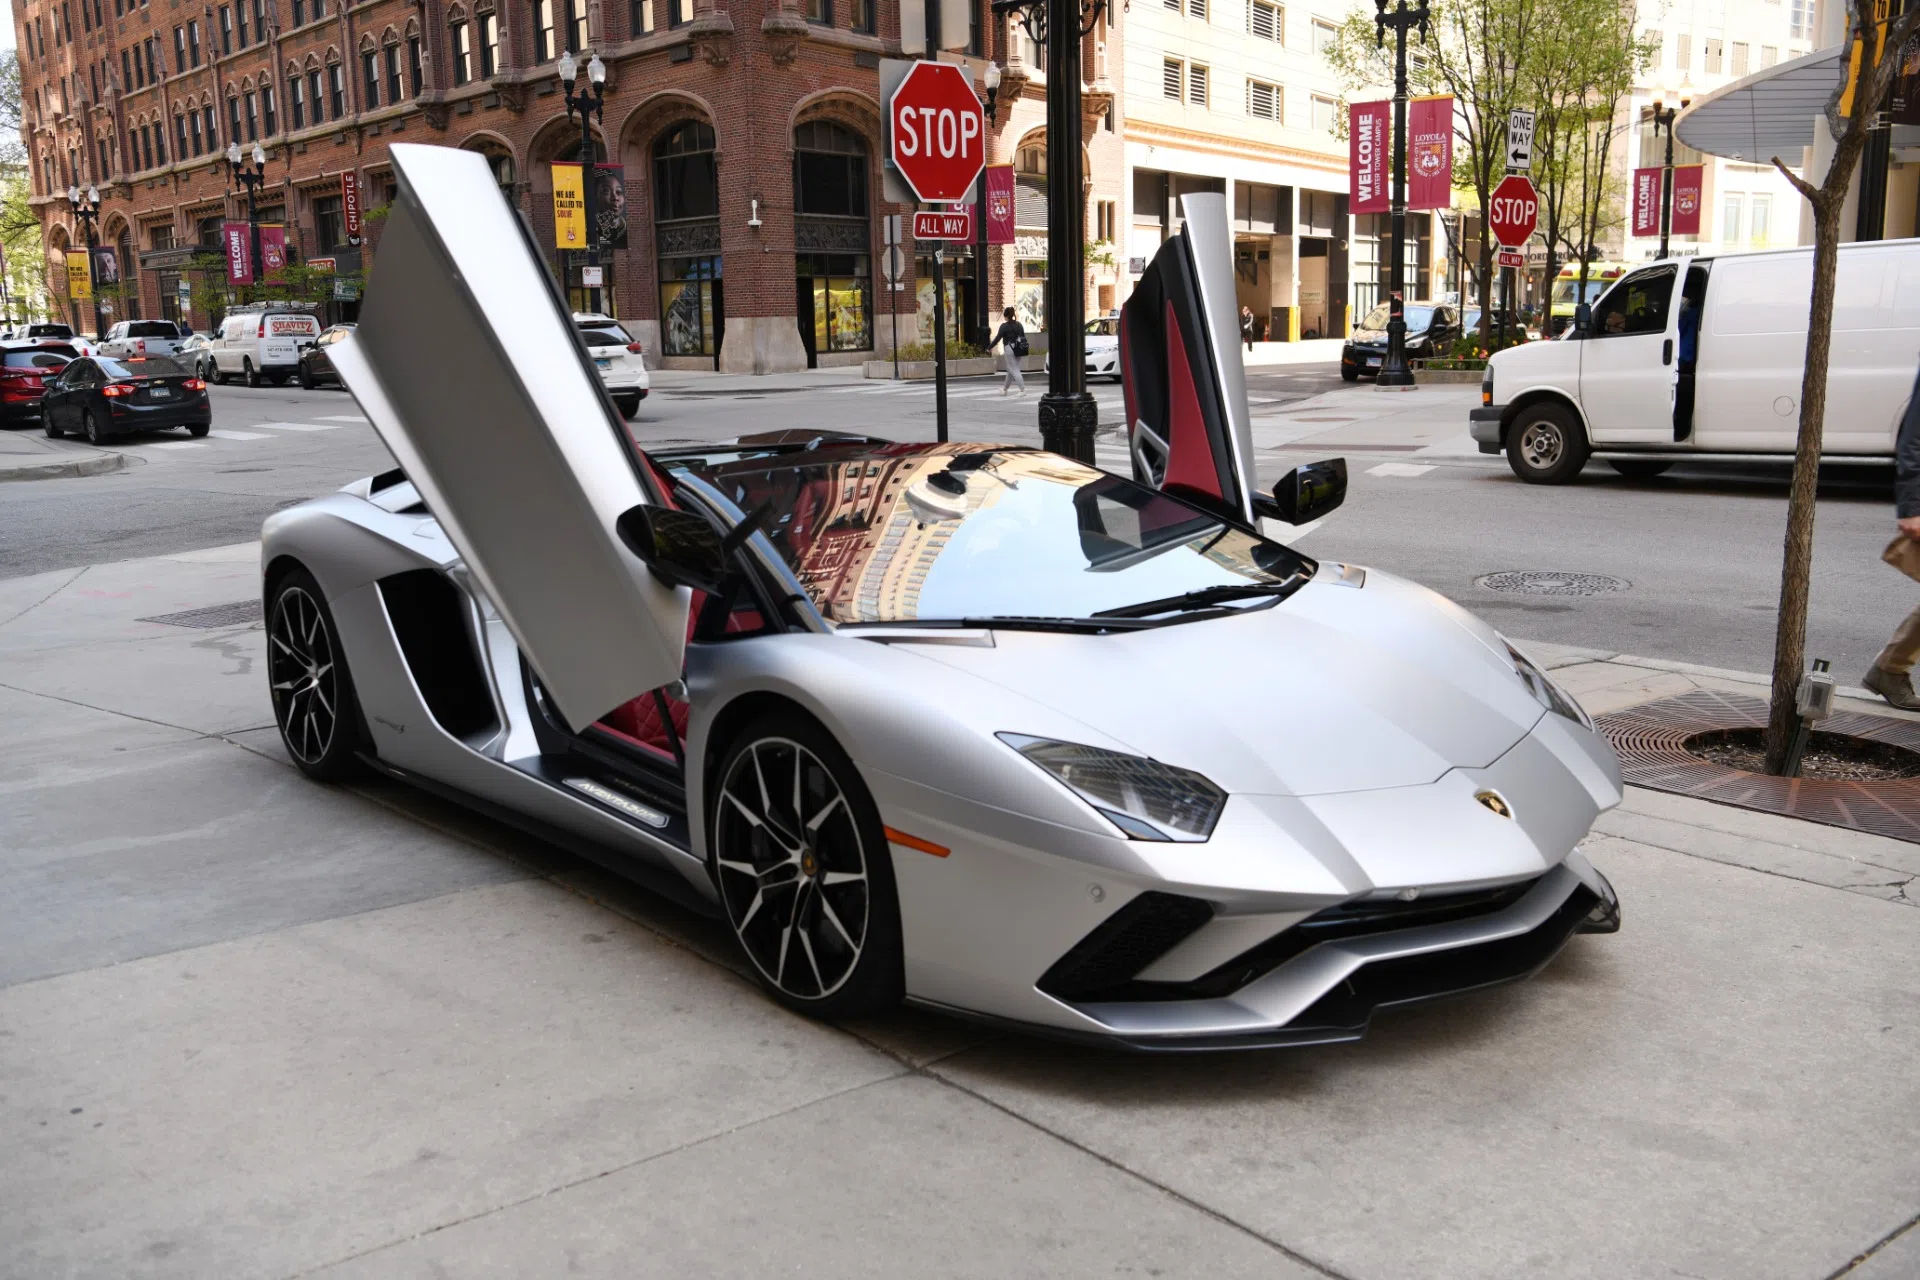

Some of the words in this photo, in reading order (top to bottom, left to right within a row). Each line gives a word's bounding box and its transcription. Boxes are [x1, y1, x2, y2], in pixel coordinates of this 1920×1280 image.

[1512, 115, 1532, 131] ONE
[899, 105, 979, 159] STOP
[1415, 132, 1447, 141] LOYOLA
[1511, 131, 1531, 146] WAY
[1358, 114, 1373, 203] WELCOME
[556, 190, 564, 198] WE
[345, 175, 358, 231] CHIPOTLE
[1637, 175, 1650, 230] WELCOME
[1492, 197, 1536, 226] STOP
[919, 218, 940, 234] ALL
[943, 219, 964, 234] WAY
[230, 231, 243, 278] WELCOME
[1500, 254, 1511, 264] ALL
[1512, 256, 1522, 266] WAY
[272, 321, 313, 333] SHAVITZ
